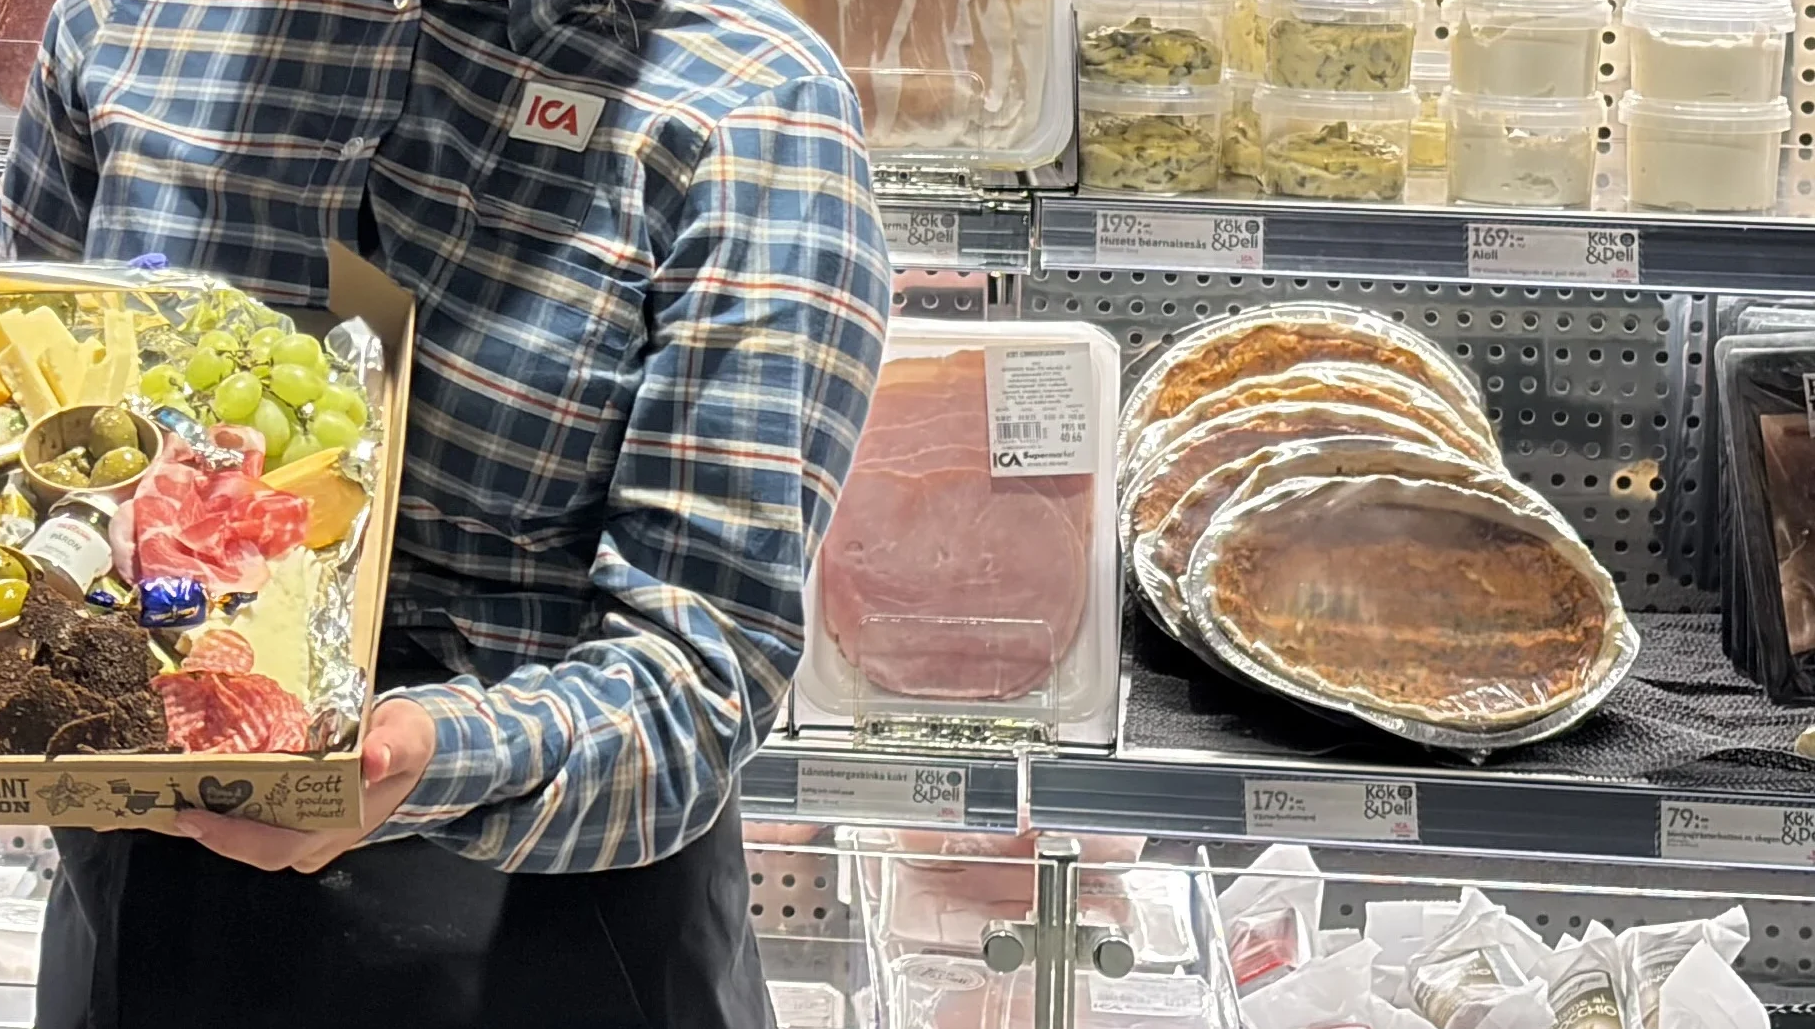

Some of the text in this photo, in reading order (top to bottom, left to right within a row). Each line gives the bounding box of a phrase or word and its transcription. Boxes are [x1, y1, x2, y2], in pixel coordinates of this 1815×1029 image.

[526, 95, 579, 136] ICA
[910, 213, 938, 229] Kök
[1214, 219, 1244, 234] Kök
[907, 228, 954, 247] &Deli
[1100, 236, 1135, 248] Husets
[1212, 233, 1259, 251] &Deli
[1587, 230, 1620, 247] Kök
[1585, 246, 1635, 265] &Deli
[993, 452, 1023, 468] ICA
[295, 774, 344, 794] Gott
[915, 769, 944, 786] Kök
[912, 785, 960, 804] &Deli
[1365, 783, 1396, 800] Kök
[1363, 800, 1413, 820] &Deli
[1783, 810, 1814, 827] Kök
